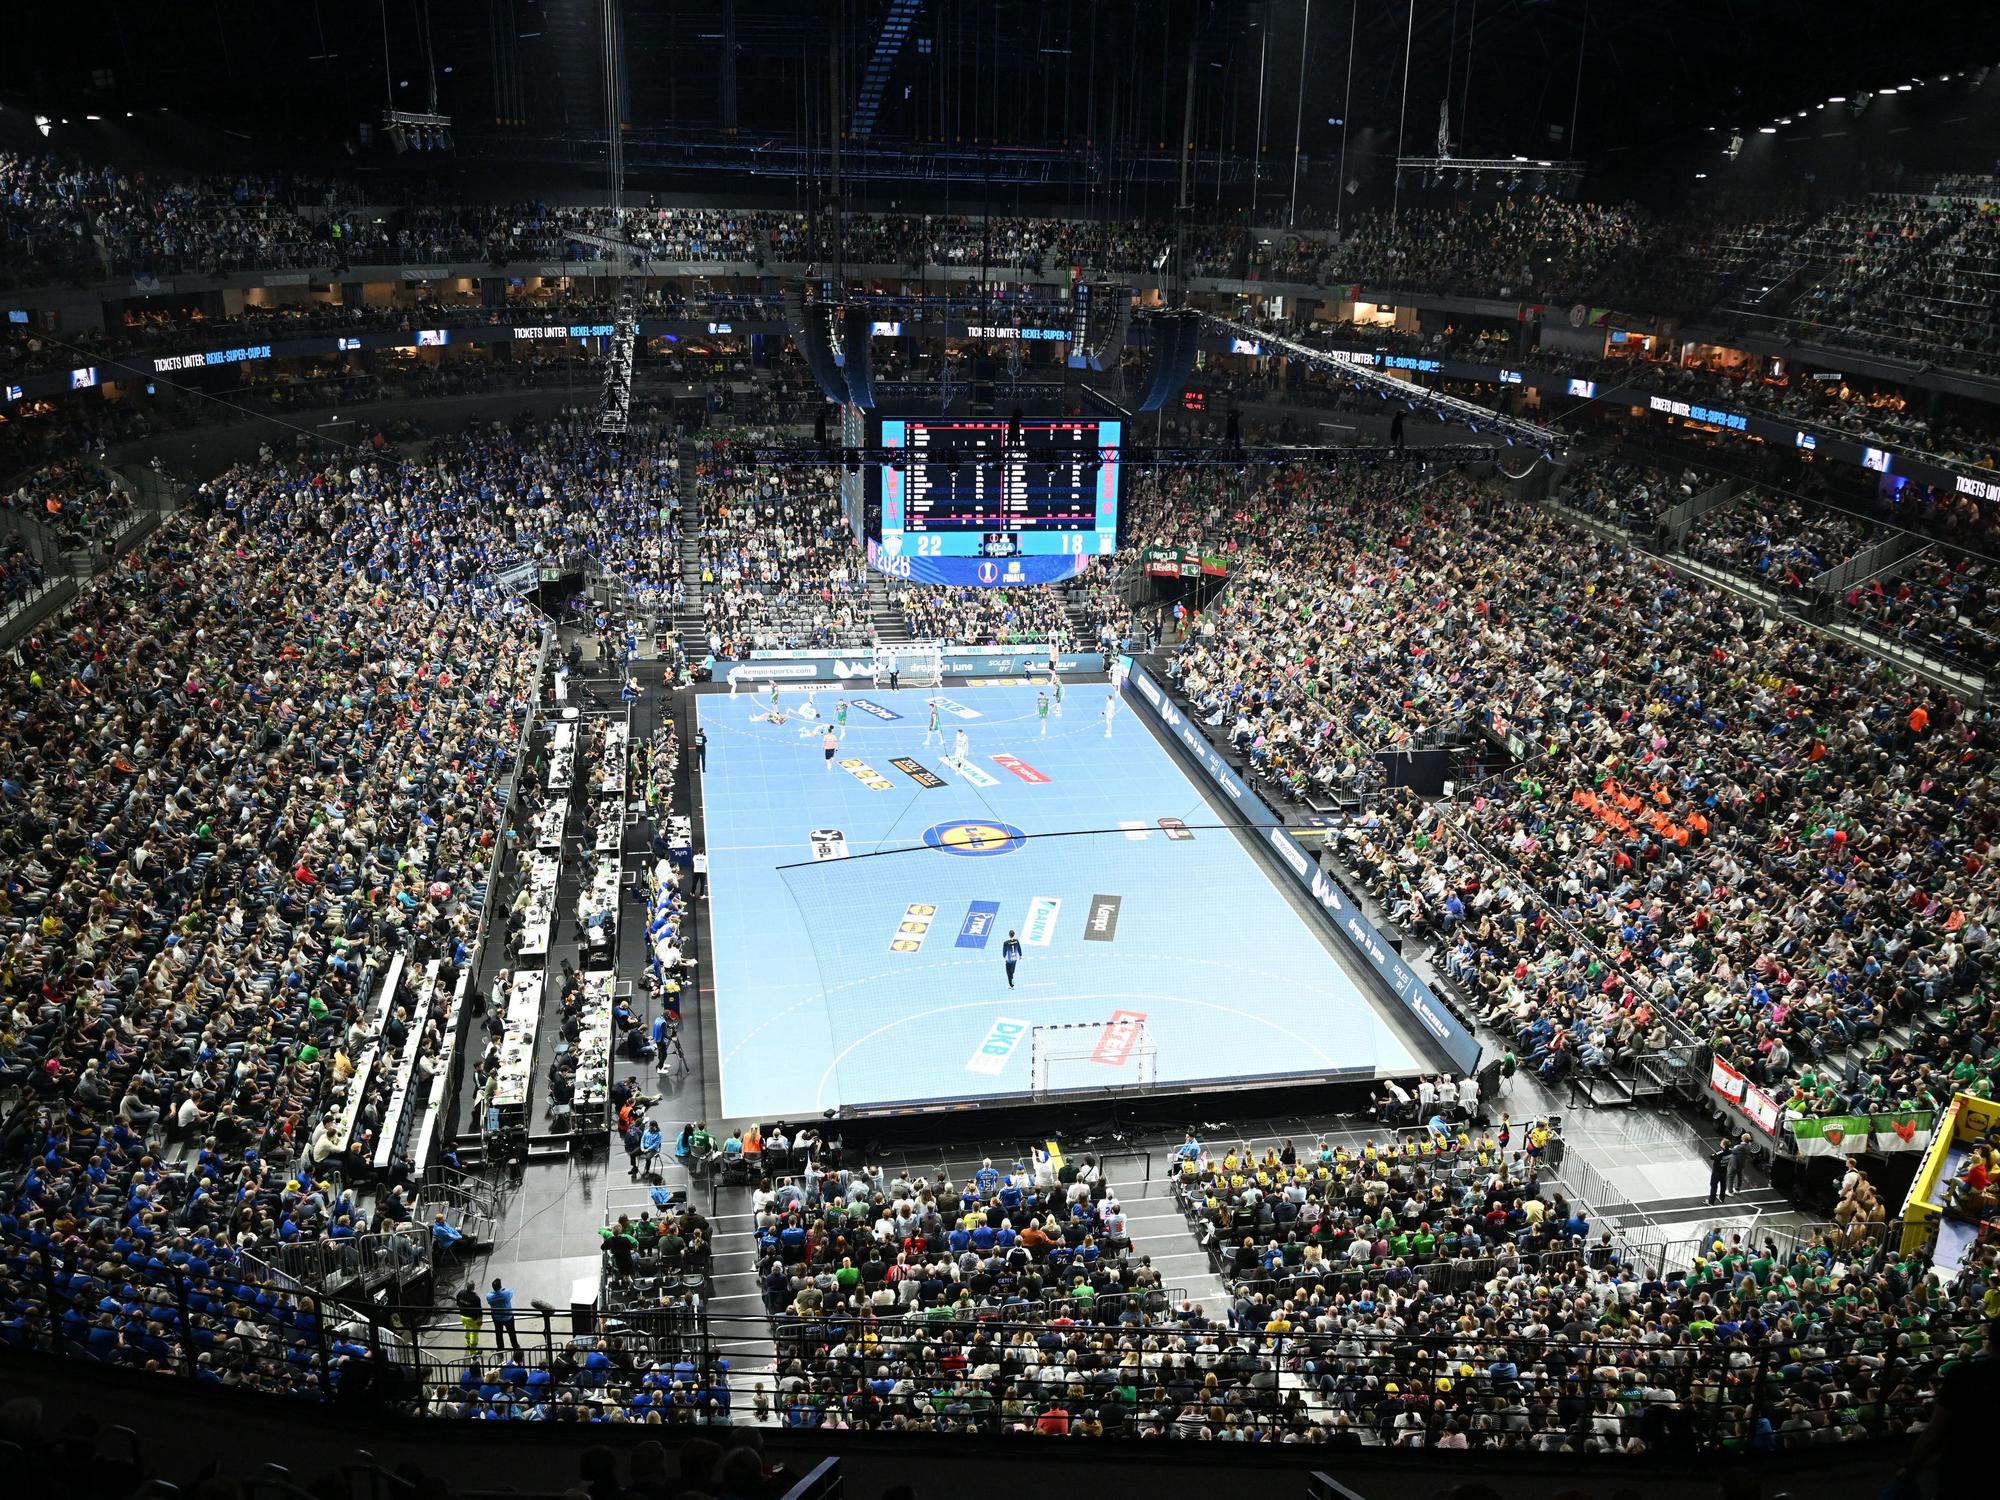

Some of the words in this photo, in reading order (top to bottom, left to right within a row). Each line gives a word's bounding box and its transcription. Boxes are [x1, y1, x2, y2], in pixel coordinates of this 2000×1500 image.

[514, 327, 543, 339] TICKETS
[968, 327, 995, 338] TICKETS
[154, 357, 181, 372] TICKETS
[182, 354, 205, 369] UNTER:
[206, 345, 271, 365] REXEL-SUPER-CUP.DE
[1650, 396, 1672, 412] TICKETS
[1956, 476, 1986, 498] TICKETS
[917, 535, 942, 556] 22
[1061, 534, 1083, 554] 18
[953, 662, 973, 672] june
[969, 917, 986, 936] JYSK
[1029, 909, 1051, 942] DAIKIN
[1093, 904, 1116, 931] Kempa
[1348, 918, 1365, 942] drops
[1364, 934, 1372, 950] in
[1370, 942, 1385, 964] june
[1392, 964, 1409, 983] SOLES
[1396, 981, 1405, 991] BY
[1421, 1003, 1450, 1039] MICHELIN
[982, 1022, 1024, 1055] DKB
